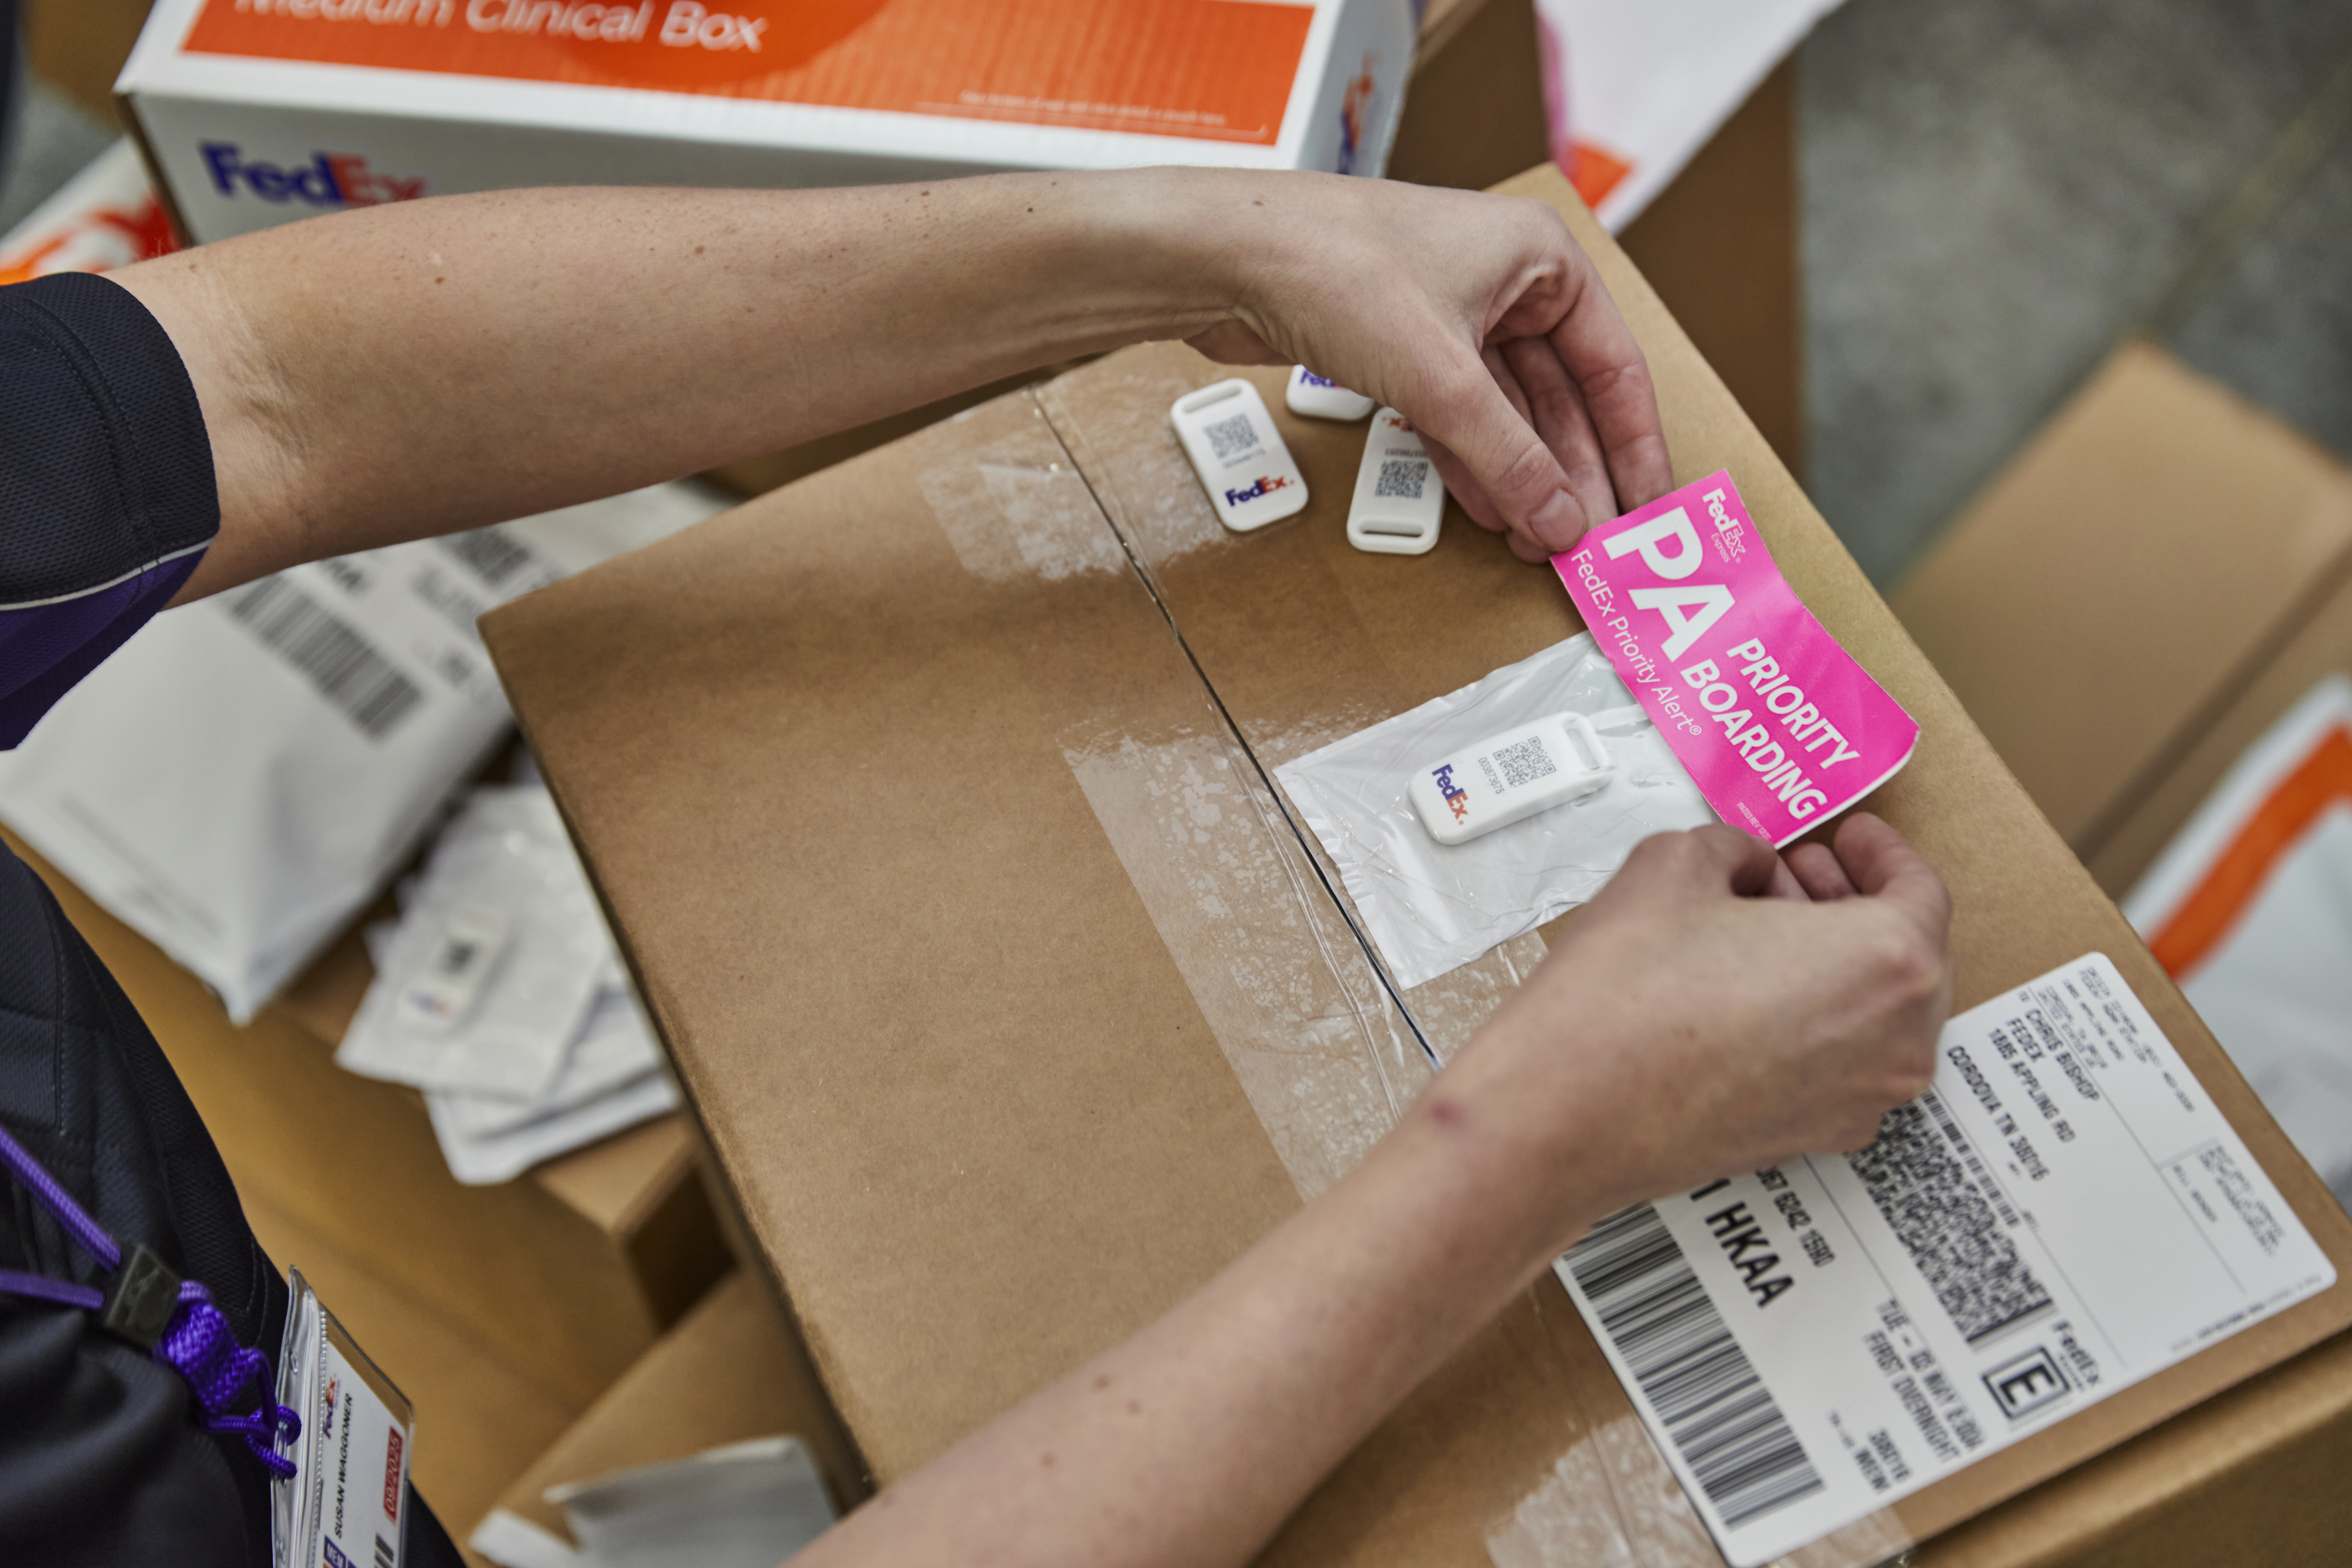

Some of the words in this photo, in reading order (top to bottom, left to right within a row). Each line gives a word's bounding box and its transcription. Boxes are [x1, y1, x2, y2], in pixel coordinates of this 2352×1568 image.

[465, 0, 657, 43] Clinical
[659, 0, 769, 53] Box
[199, 138, 426, 207] FedEx
[1300, 368, 1349, 391] Fed
[1225, 475, 1289, 508] FedEx
[1602, 505, 1736, 663] PA
[1711, 532, 1731, 563] Express
[1571, 549, 1616, 617] FedEx
[1607, 616, 1661, 685] Priority
[1680, 658, 1828, 820] BOARDING
[1726, 637, 1861, 770] PRIORITY
[1478, 757, 1505, 794] 003873675
[2006, 1017, 2046, 1062] FEDEX
[2025, 1009, 2064, 1051] CHRIS
[2055, 1051, 2100, 1101] BISHOP
[1947, 1045, 2002, 1115] CORDOVA
[1995, 1113, 2019, 1137] TN
[2009, 1135, 2050, 1181] 38016
[1988, 1028, 2018, 1060] 1885
[2011, 1061, 2060, 1120] APPLING
[2052, 1119, 2076, 1143] RD
[1705, 1200, 1795, 1309] HKAA
[1862, 1329, 1905, 1378] FIRST
[1892, 1373, 1962, 1464] OVERNIGHT
[1923, 1370, 1959, 1408] MAY
[1999, 1363, 2055, 1408] E
[338, 1392, 353, 1484] WAGGONER
[385, 1436, 400, 1513] 09/2025
[334, 1484, 345, 1539] SUSAN
